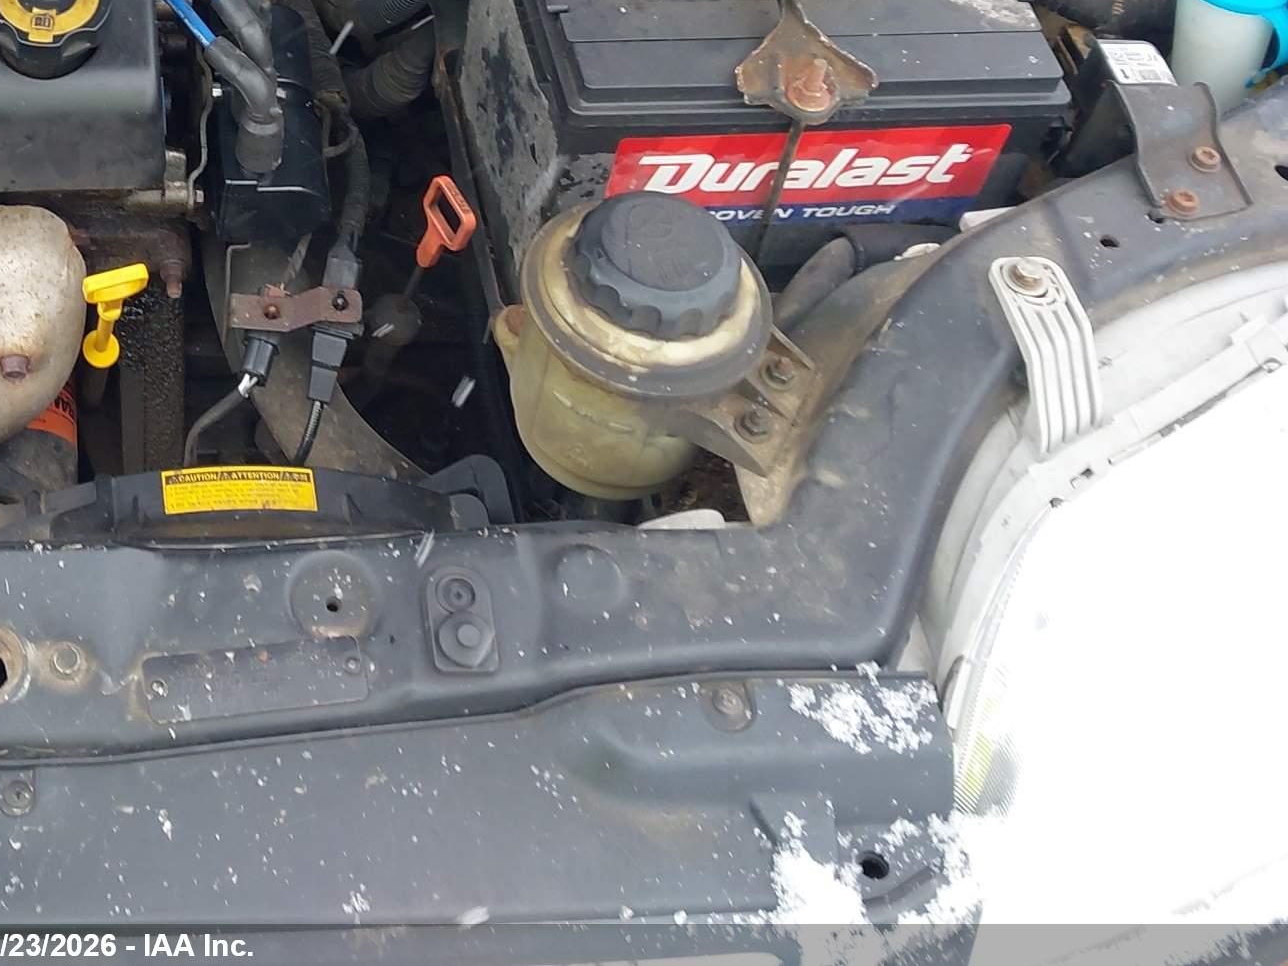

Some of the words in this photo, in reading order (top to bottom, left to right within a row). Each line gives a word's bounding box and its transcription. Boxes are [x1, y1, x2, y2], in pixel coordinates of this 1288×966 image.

[638, 142, 974, 195] Duralast
[709, 207, 795, 222] OVEN
[802, 203, 897, 218] TOUGH
[178, 473, 217, 484] CAUTION
[231, 472, 280, 482] ATTENTION
